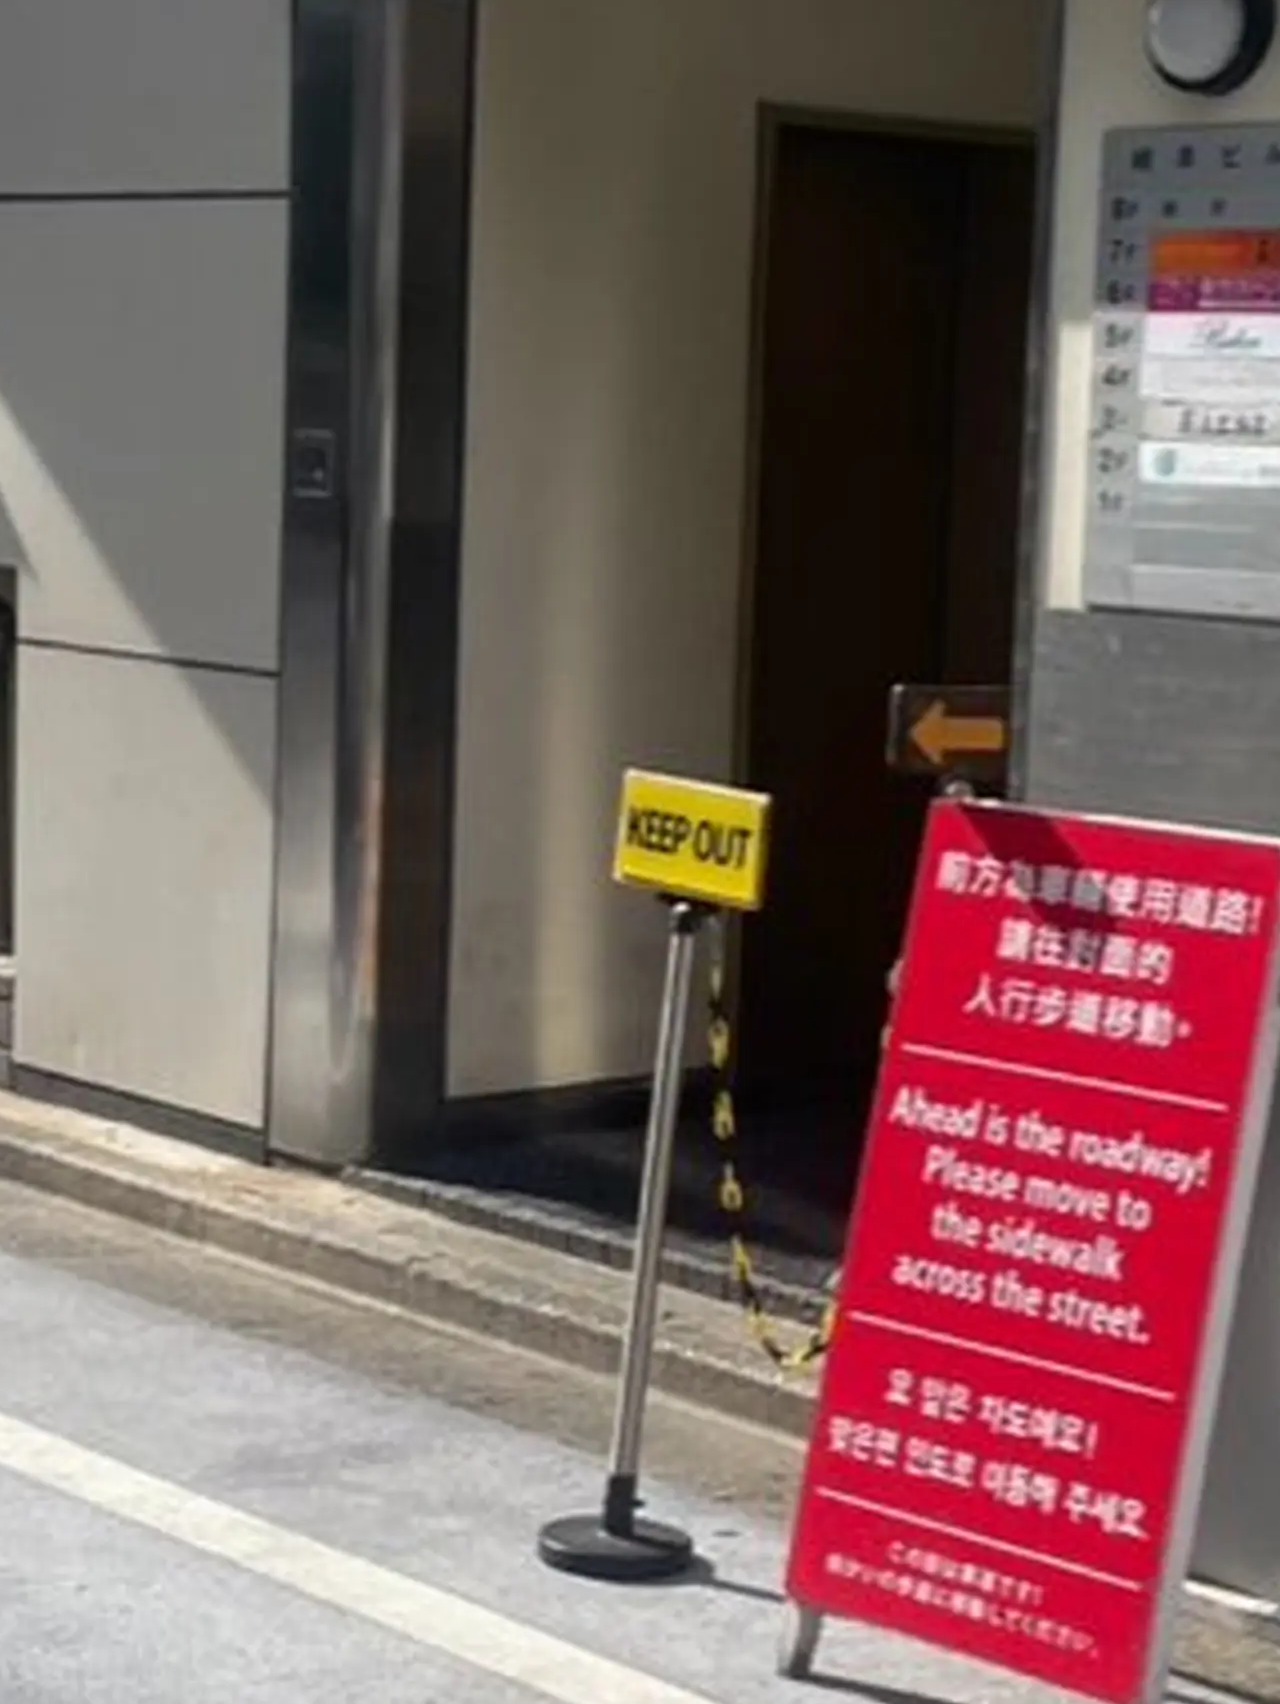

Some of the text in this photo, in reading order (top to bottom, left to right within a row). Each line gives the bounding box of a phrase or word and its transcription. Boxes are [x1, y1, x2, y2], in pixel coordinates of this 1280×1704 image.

[627, 805, 752, 870] KEEP OUT
[890, 1088, 1212, 1193] Ahead is the roadway!
[923, 1147, 1152, 1229] Please move to
[932, 1201, 1125, 1278] the sidewalk
[892, 1253, 1153, 1342] across the street.
